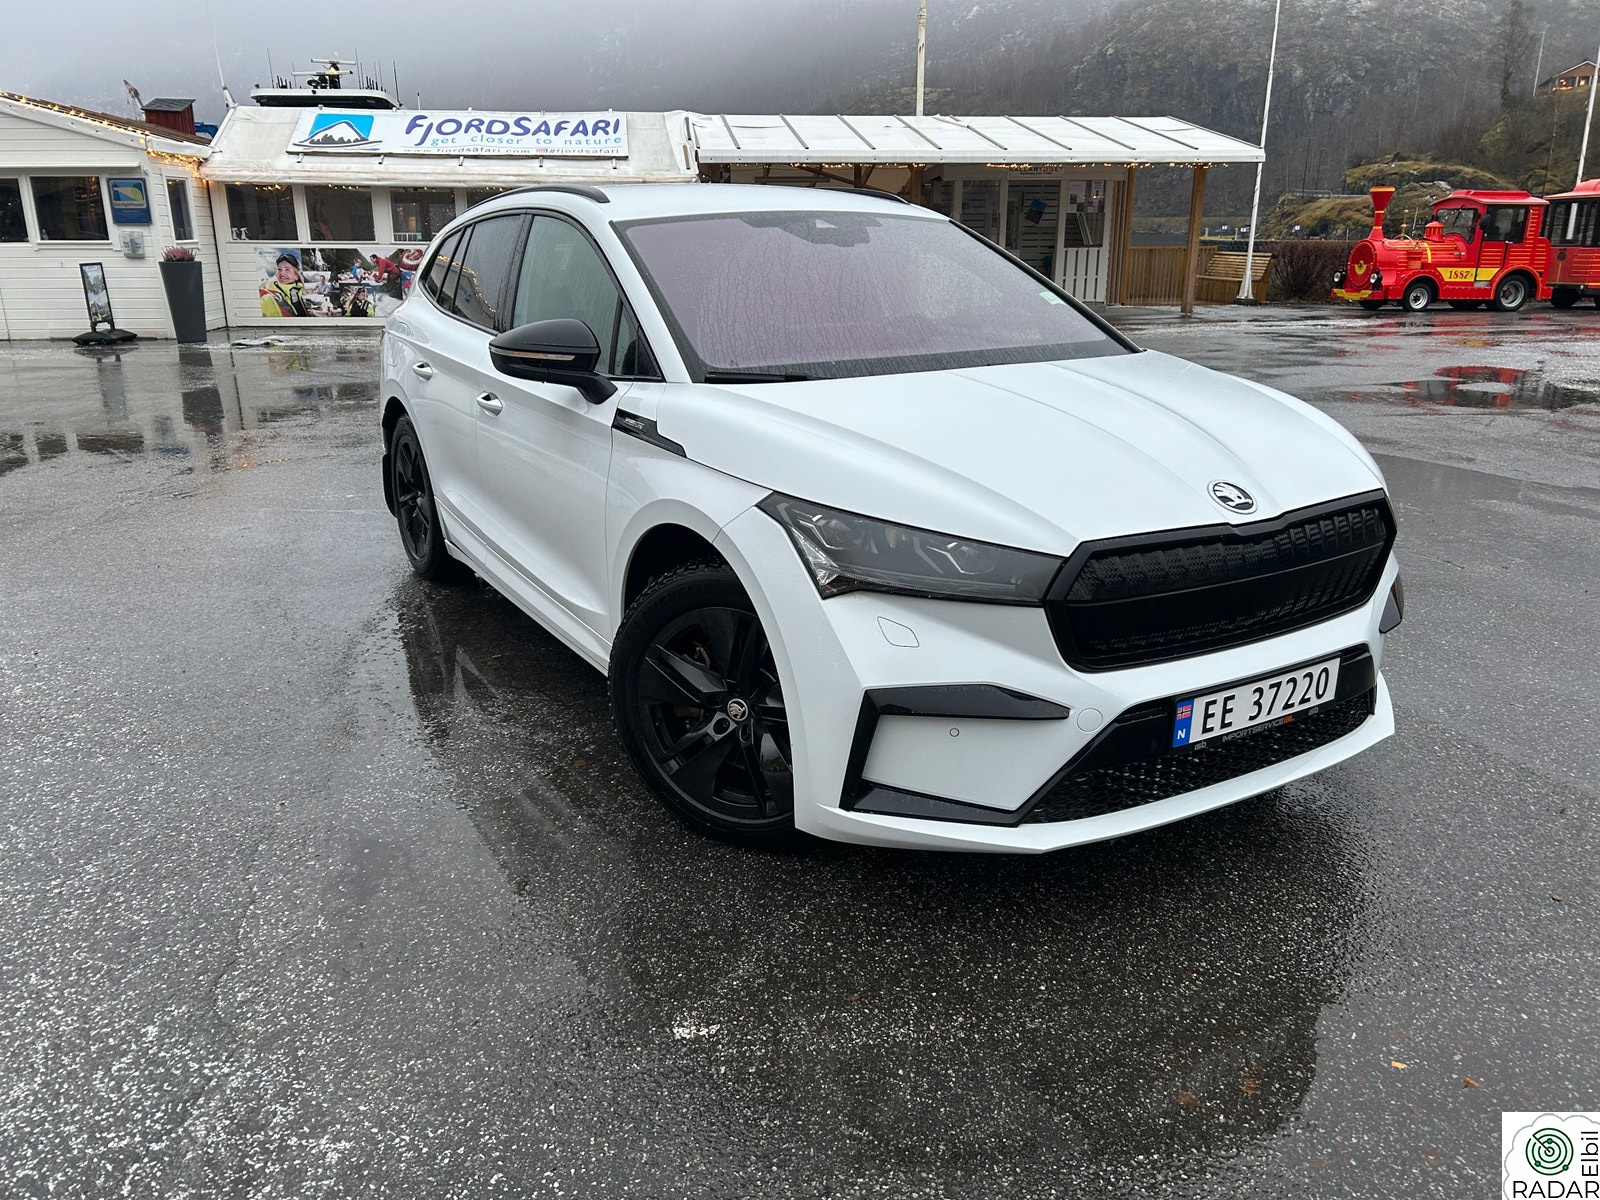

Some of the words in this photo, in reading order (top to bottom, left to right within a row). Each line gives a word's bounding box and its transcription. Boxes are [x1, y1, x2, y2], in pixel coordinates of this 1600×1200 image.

[431, 137, 457, 146] get
[470, 134, 523, 145] closer
[536, 137, 552, 145] to
[564, 136, 622, 146] nature
[1448, 270, 1471, 280] 1887
[1201, 694, 1236, 735] EE
[1248, 666, 1330, 721] 37220
[1177, 728, 1186, 740] N
